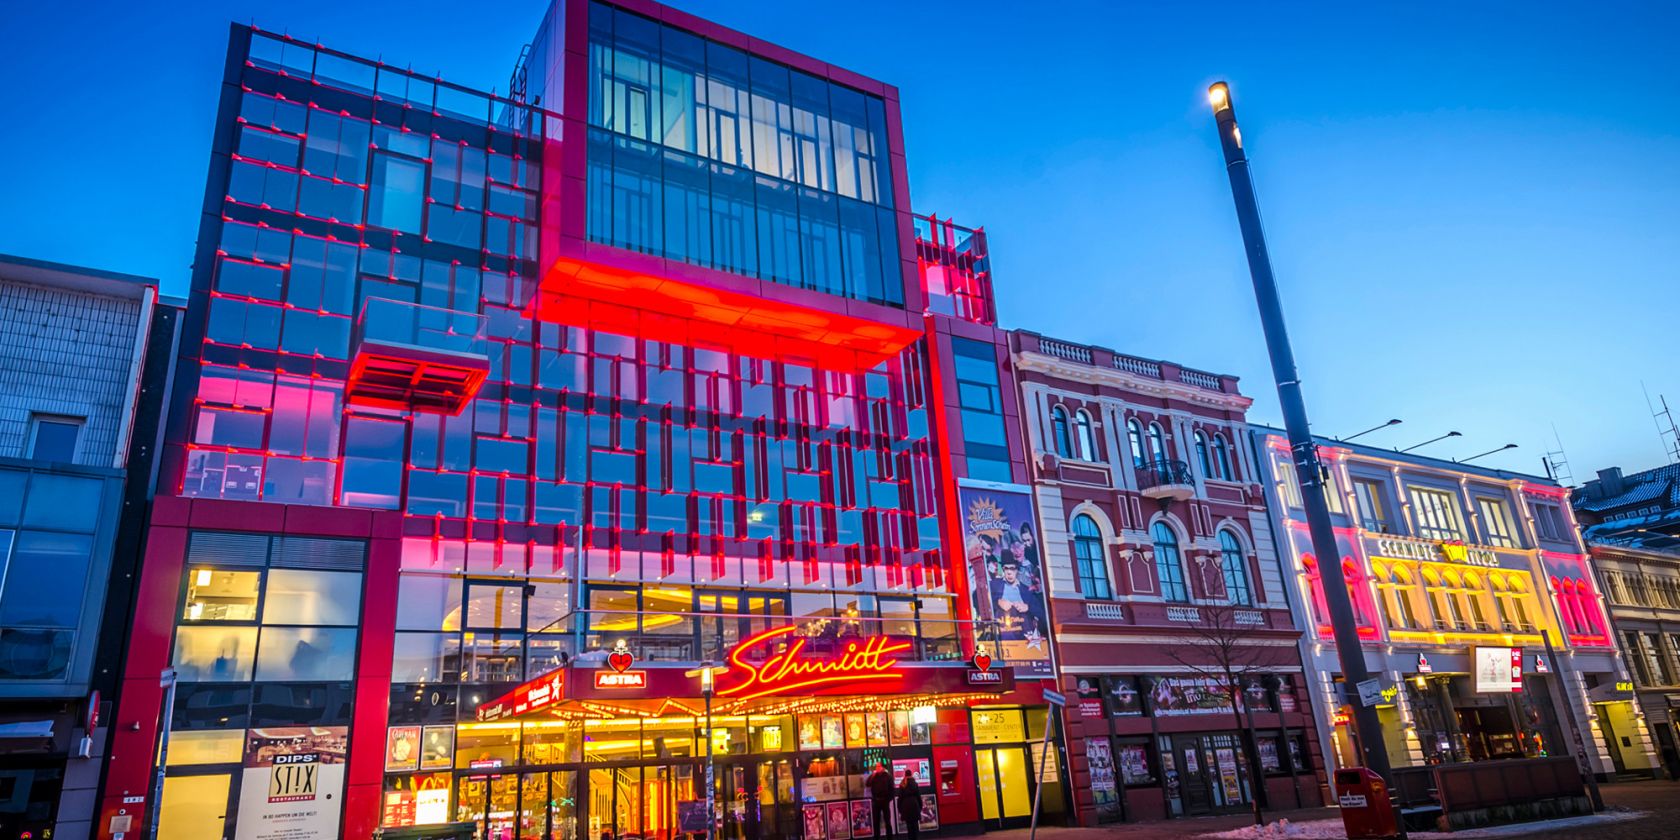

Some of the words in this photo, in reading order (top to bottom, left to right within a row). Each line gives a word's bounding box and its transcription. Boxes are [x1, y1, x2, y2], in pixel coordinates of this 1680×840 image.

[717, 625, 910, 696] Schmidt
[598, 674, 643, 686] ASTRA
[970, 672, 1000, 681] ASTRA
